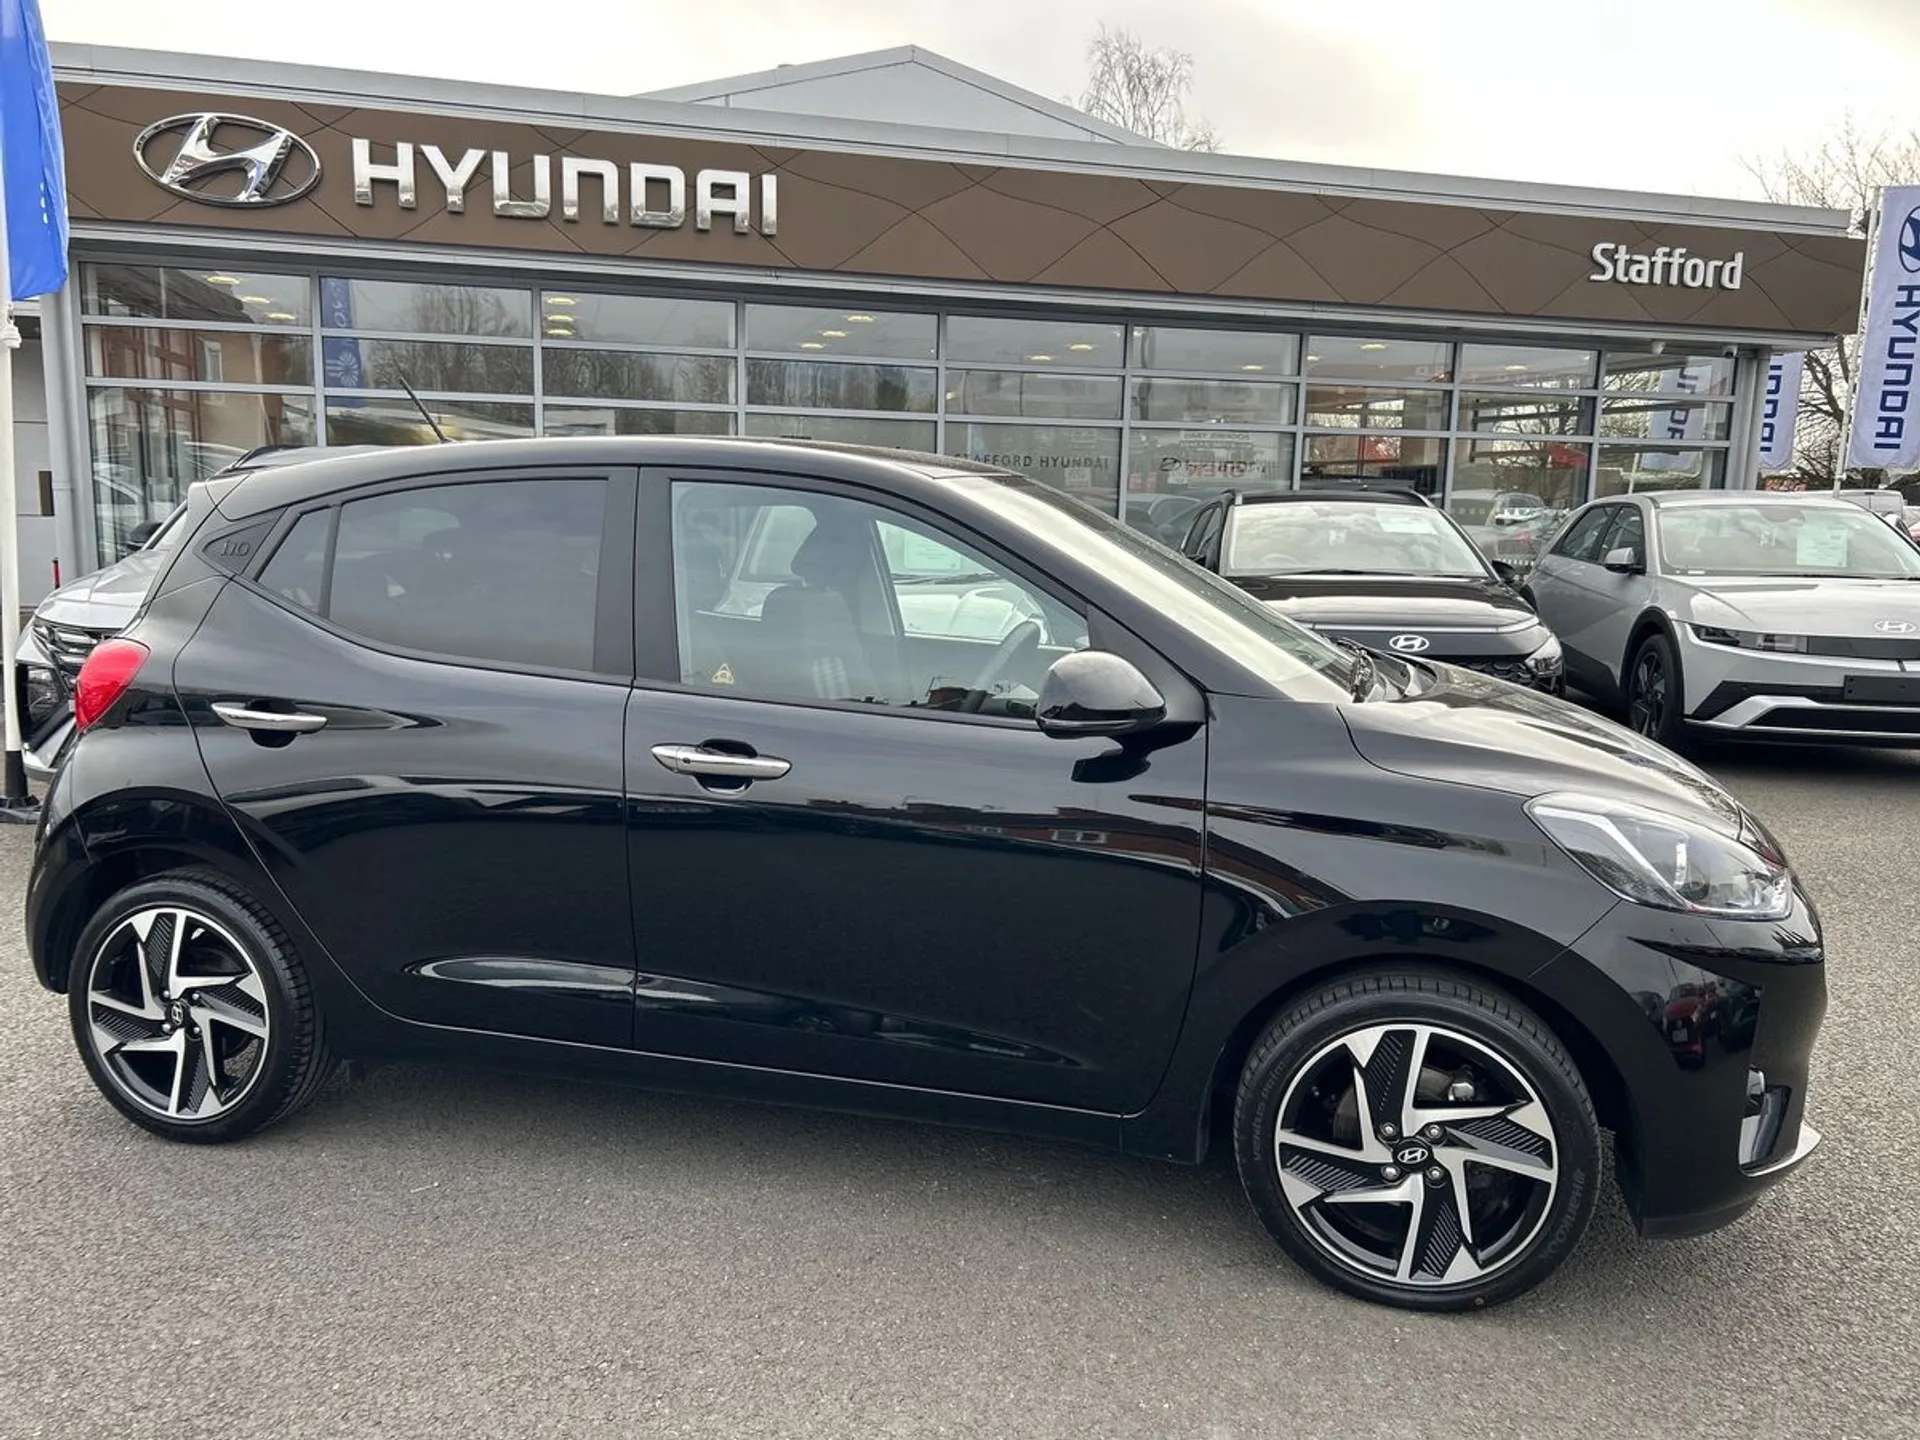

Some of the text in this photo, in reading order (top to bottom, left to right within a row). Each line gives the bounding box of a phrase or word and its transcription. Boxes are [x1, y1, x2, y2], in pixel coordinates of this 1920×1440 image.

[352, 138, 778, 236] HYUNDAI
[1589, 242, 1744, 290] Stafford
[1874, 285, 1920, 450] HYUNDAI
[1039, 456, 1109, 469] HYUNDAI
[220, 539, 251, 557] i10
